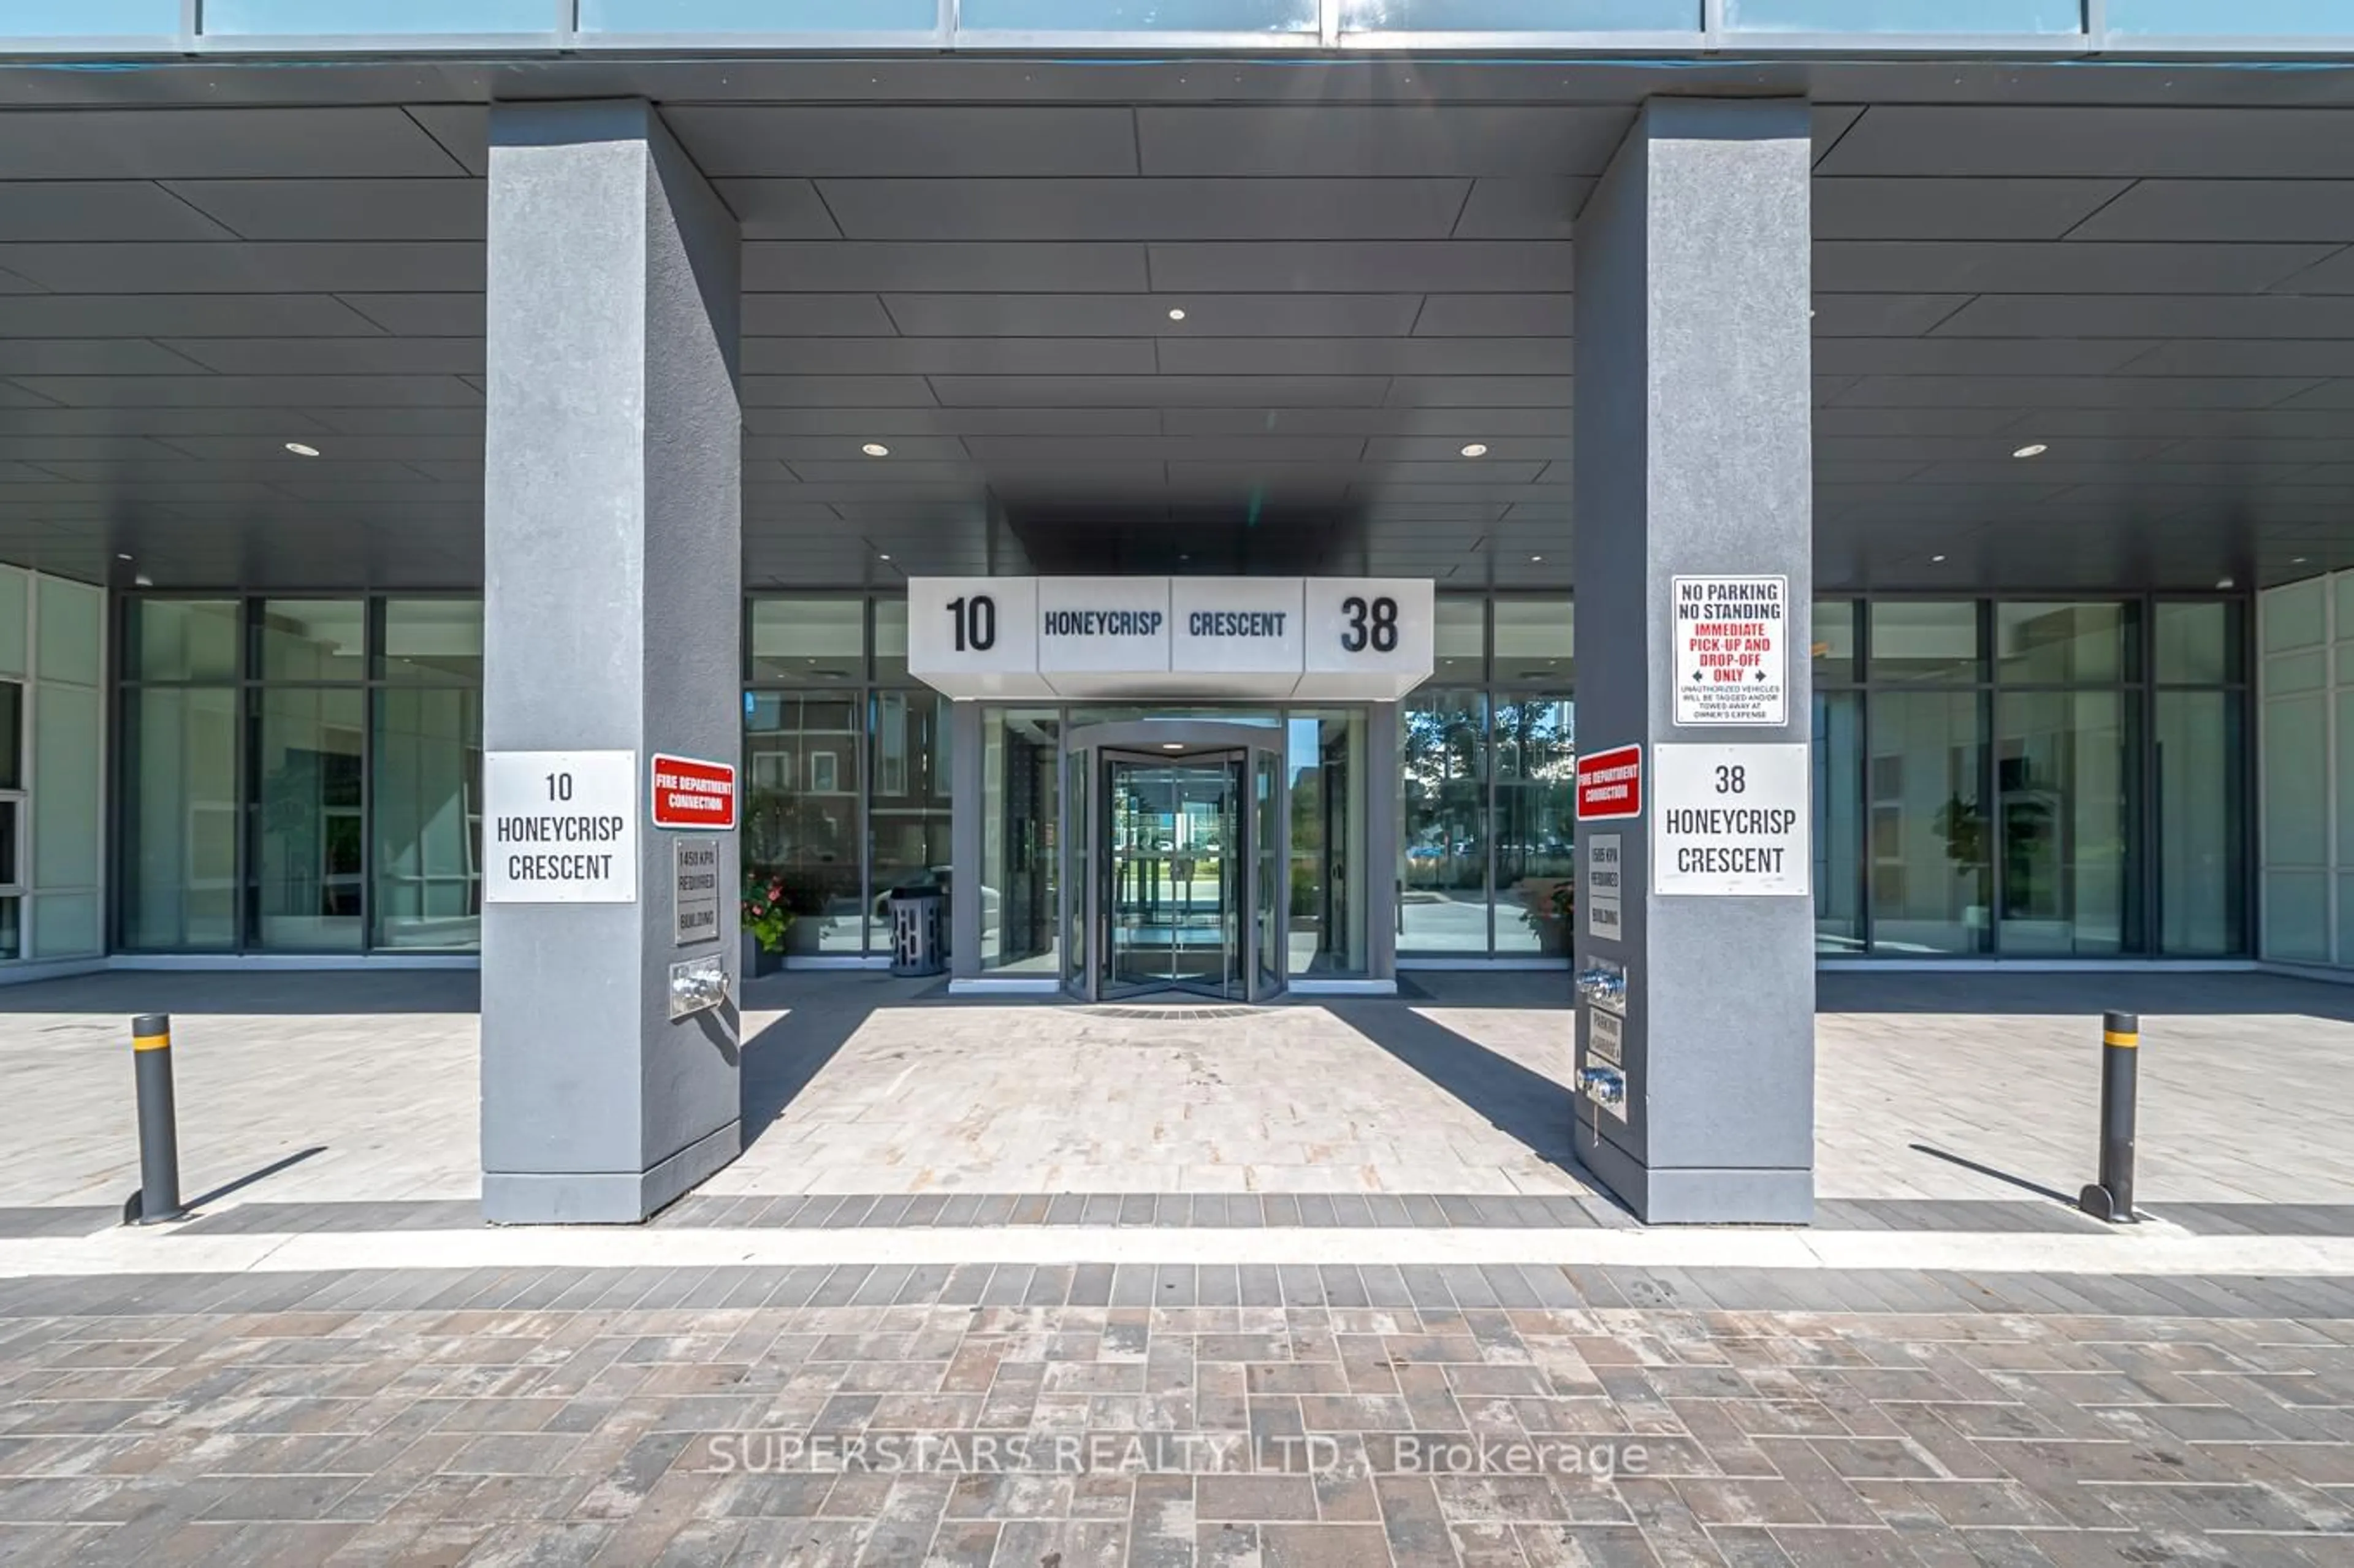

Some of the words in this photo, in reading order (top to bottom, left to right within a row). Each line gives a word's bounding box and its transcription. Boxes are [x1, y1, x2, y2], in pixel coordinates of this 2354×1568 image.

[1682, 584, 1702, 600] NO
[1708, 584, 1778, 600] PARKING
[1679, 604, 1699, 619] NO
[1704, 604, 1781, 619] STANDING
[947, 596, 996, 652] 10
[1045, 610, 1162, 637] HONEYCRISP
[1189, 612, 1286, 637] CRESCENT
[1341, 596, 1398, 652] 38
[1694, 623, 1766, 636] IMMEDIATE
[1689, 638, 1742, 652] PICK-UP
[1745, 638, 1770, 652] AND
[1700, 653, 1761, 667] DROP-OFF
[1713, 669, 1744, 682] ONLY
[545, 773, 573, 801] 10
[656, 774, 677, 790] FIRE
[1716, 765, 1745, 794] 38
[498, 816, 623, 842] HONEYCRISP
[1667, 809, 1796, 834] HONEYCRISP
[508, 854, 612, 880] CRESCENT
[1678, 848, 1784, 873] CRESCENT
